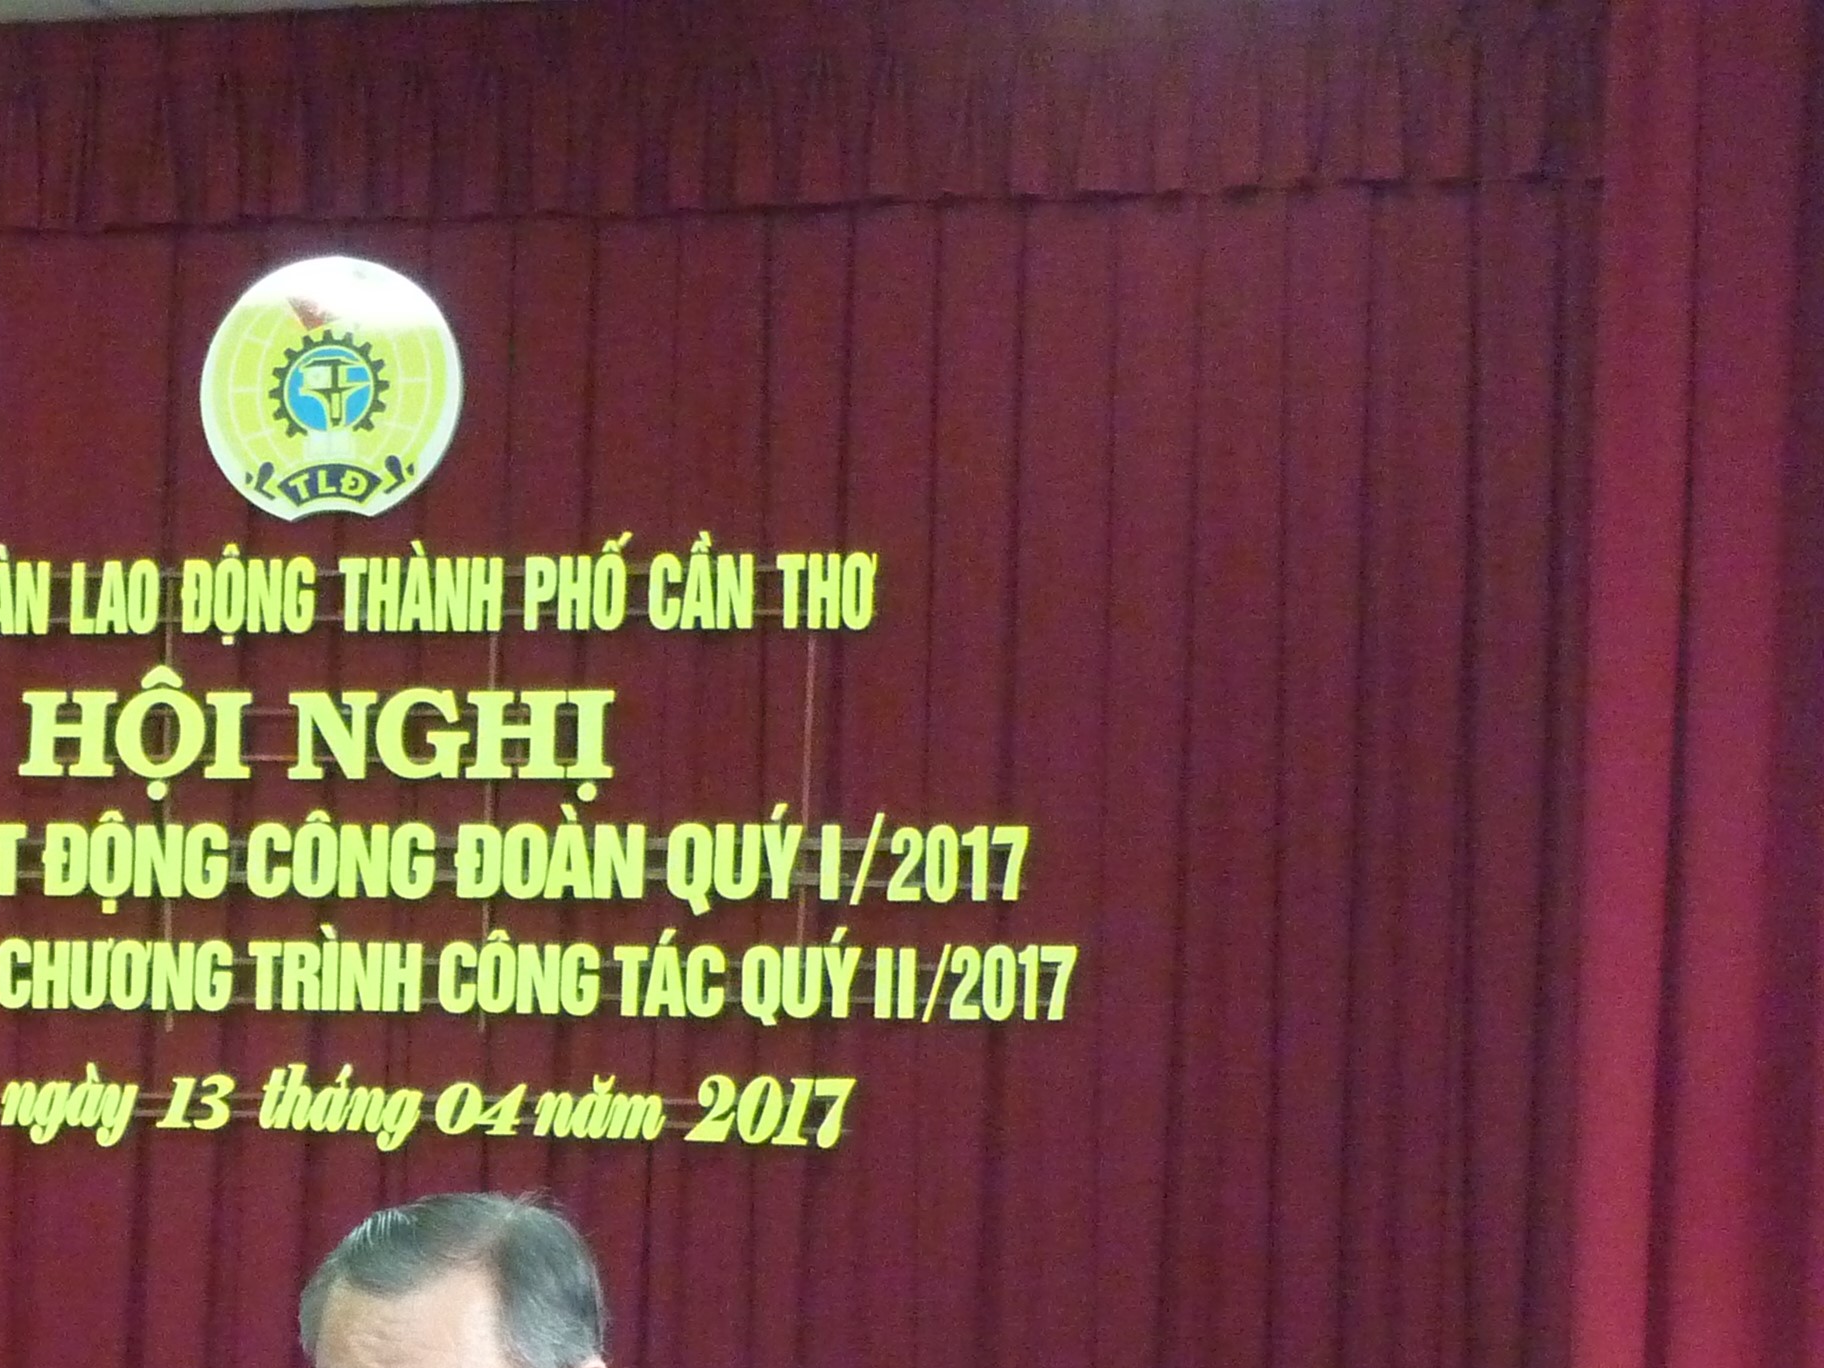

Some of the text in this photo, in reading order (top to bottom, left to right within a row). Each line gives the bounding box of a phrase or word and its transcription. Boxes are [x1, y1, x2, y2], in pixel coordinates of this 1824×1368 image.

[289, 470, 369, 500] TLĐ
[68, 557, 161, 635] LAO
[179, 542, 318, 646] ĐỘNG
[337, 539, 505, 633] THÀNH
[522, 530, 633, 632] PHỐ
[647, 530, 756, 631] CẦN
[17, 662, 616, 802] HỘI NGHỊ
[40, 808, 231, 915] ĐỘNG
[241, 808, 440, 900] CÔNG
[450, 802, 649, 900] ĐOÀN
[665, 802, 807, 917] QUÝ
[247, 922, 427, 1013] TRÌNH
[434, 928, 602, 1017] CÔNG
[612, 927, 729, 1018] TÁC
[740, 925, 863, 1027] QUÝ
[0, 1061, 140, 1148] ngày
[155, 1072, 236, 1131] 13
[258, 1062, 425, 1152] tháng
[434, 1080, 528, 1136] 04
[532, 1073, 667, 1141] năm
[683, 1073, 857, 1149] 2017
